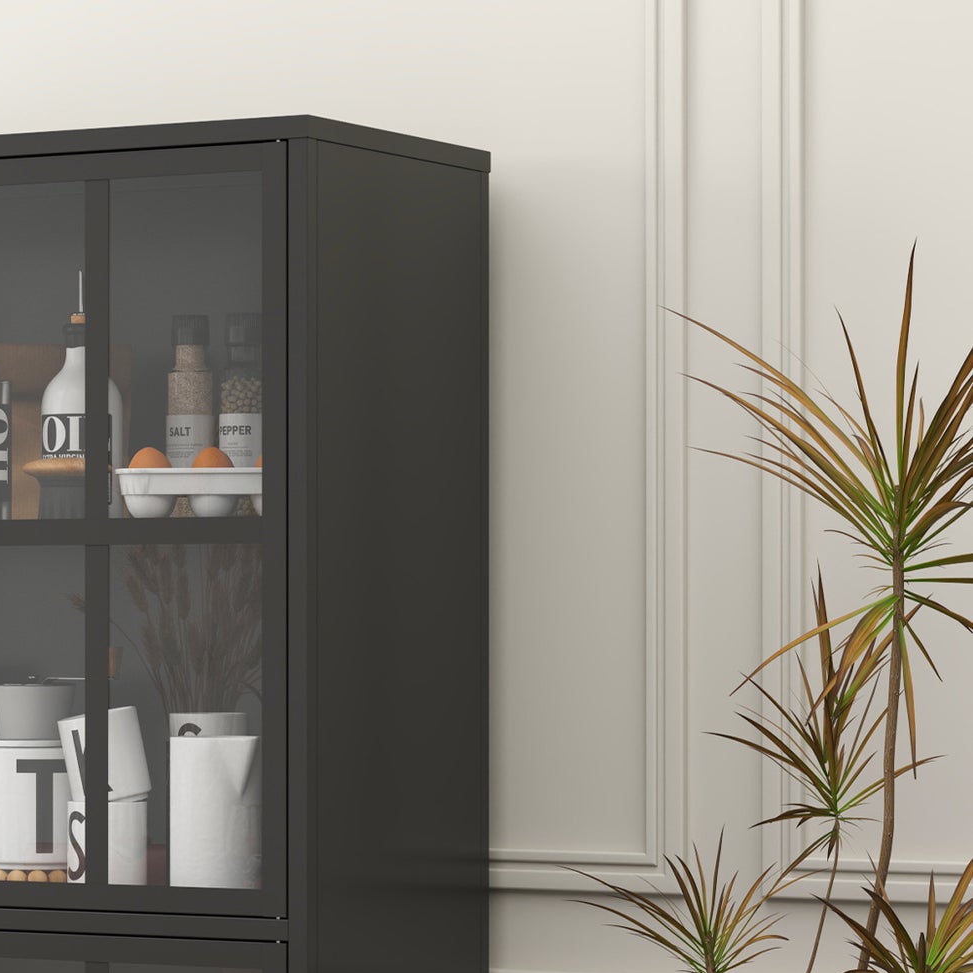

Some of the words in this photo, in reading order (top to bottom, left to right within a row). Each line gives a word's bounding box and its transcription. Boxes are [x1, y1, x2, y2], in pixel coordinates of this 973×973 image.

[43, 416, 85, 453] OI
[169, 427, 191, 437] SALT
[219, 425, 252, 436] PEPPER
[16, 759, 67, 854] T
